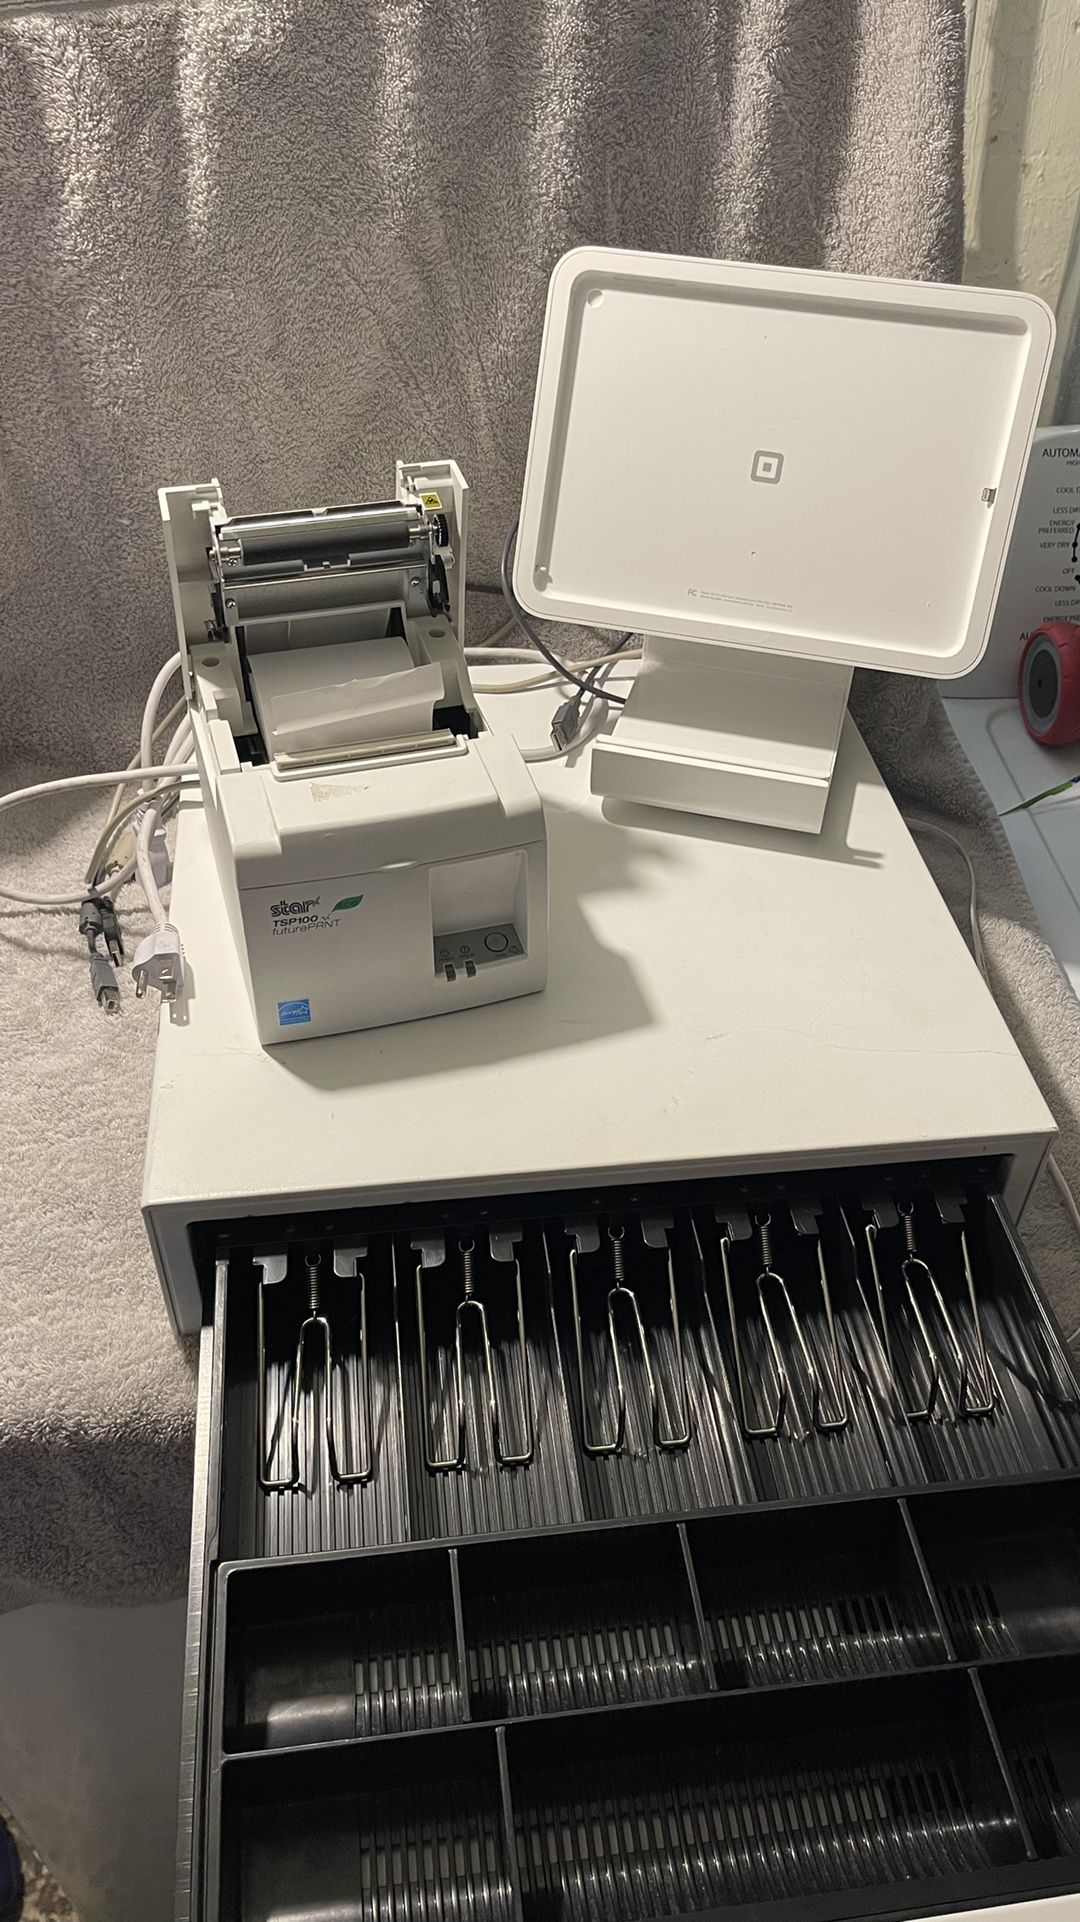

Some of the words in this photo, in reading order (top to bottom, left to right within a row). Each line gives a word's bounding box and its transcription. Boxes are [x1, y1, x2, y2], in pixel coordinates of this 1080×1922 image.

[1042, 448, 1080, 458] AUTOM
[1053, 506, 1068, 514] LESS
[272, 914, 319, 928] TSP100
[272, 919, 342, 937] futurePRNT
